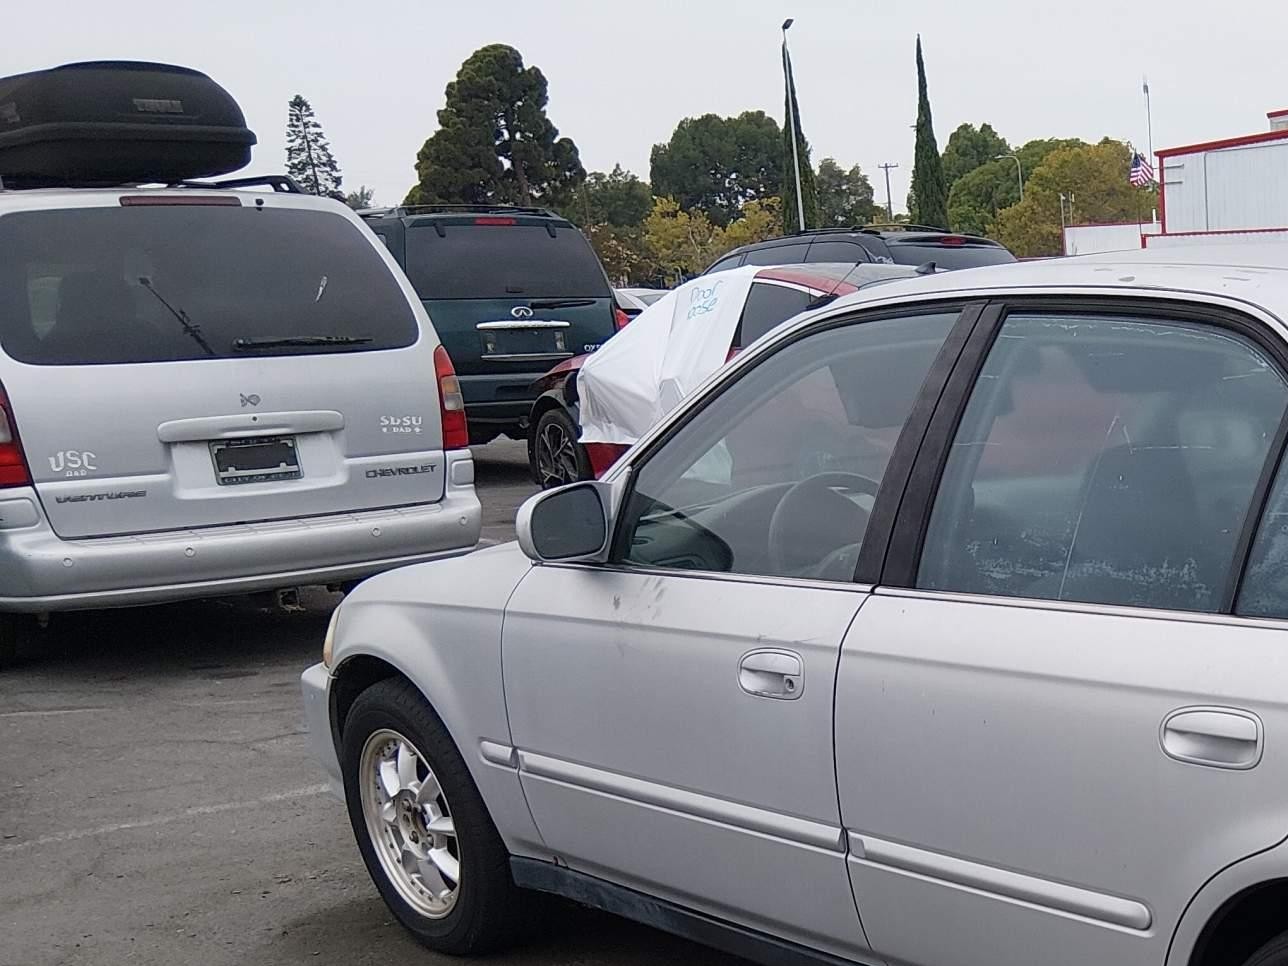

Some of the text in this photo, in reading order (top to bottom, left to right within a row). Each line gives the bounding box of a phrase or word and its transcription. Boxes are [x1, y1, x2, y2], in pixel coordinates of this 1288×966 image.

[48, 450, 97, 472] USC
[365, 464, 437, 478] CHEVROLET
[56, 490, 147, 503] VENTURE
